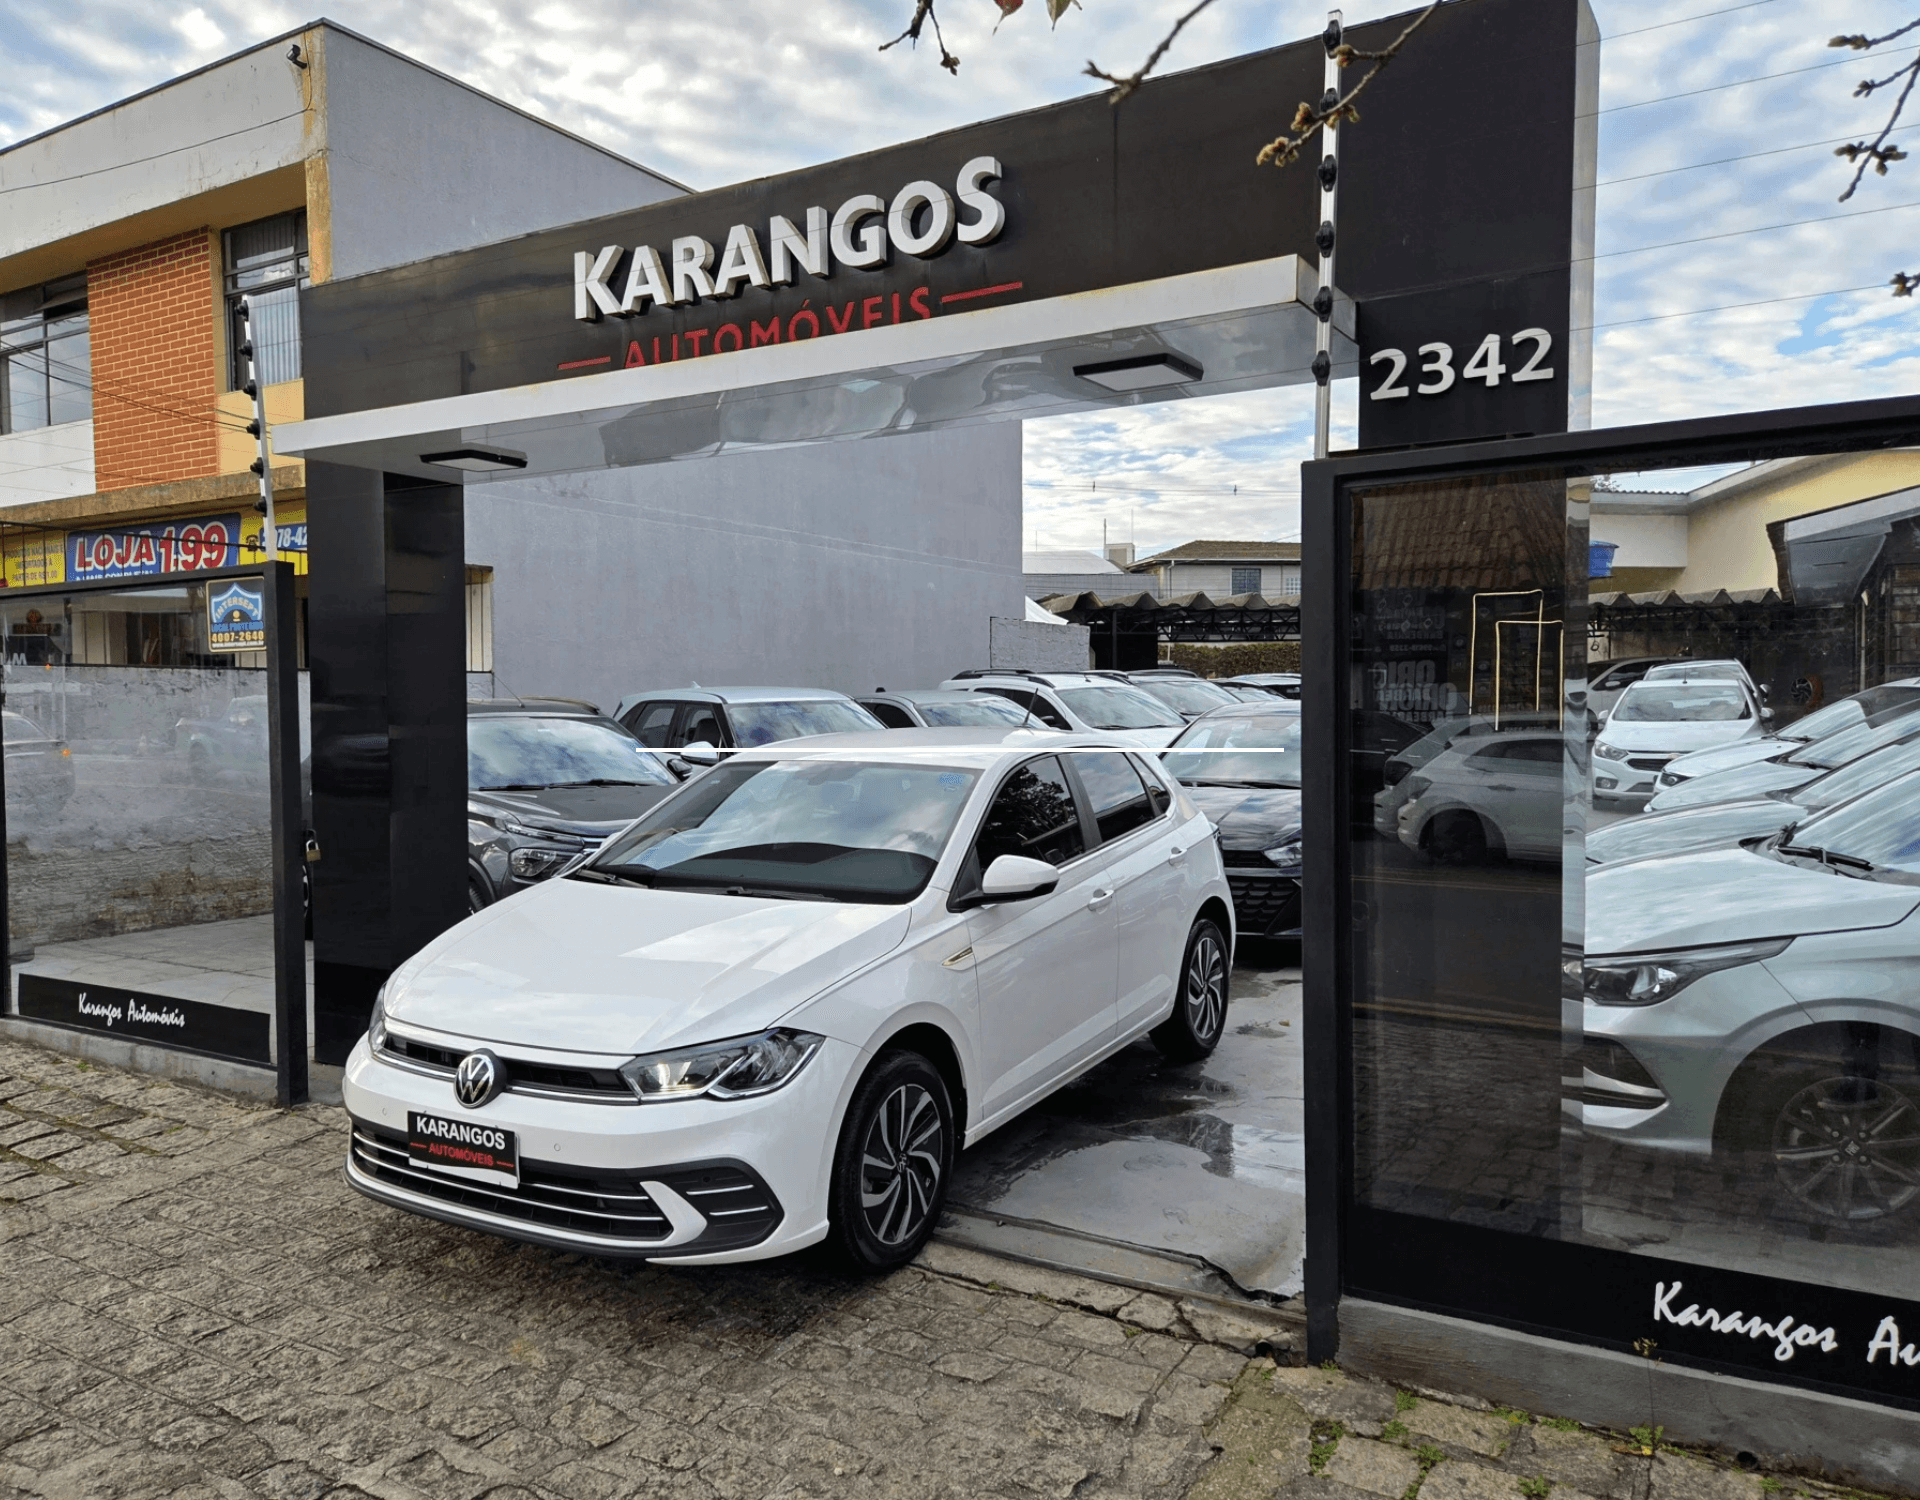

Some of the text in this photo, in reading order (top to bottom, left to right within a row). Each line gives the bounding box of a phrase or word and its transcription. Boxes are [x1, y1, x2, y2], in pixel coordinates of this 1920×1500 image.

[573, 155, 1006, 322] KARANGOS
[624, 286, 931, 369] AUTOMÓVEIS
[1370, 328, 1554, 401] 2342
[75, 530, 157, 572] LOJA
[215, 596, 259, 620] INTERSEPT
[212, 631, 264, 643] 4007-2640
[78, 993, 186, 1028] Karangos Automóveis
[416, 1115, 506, 1150] KARANGOS
[428, 1143, 494, 1167] AUTOMÓVEIS
[1653, 1281, 1839, 1362] Karangos
